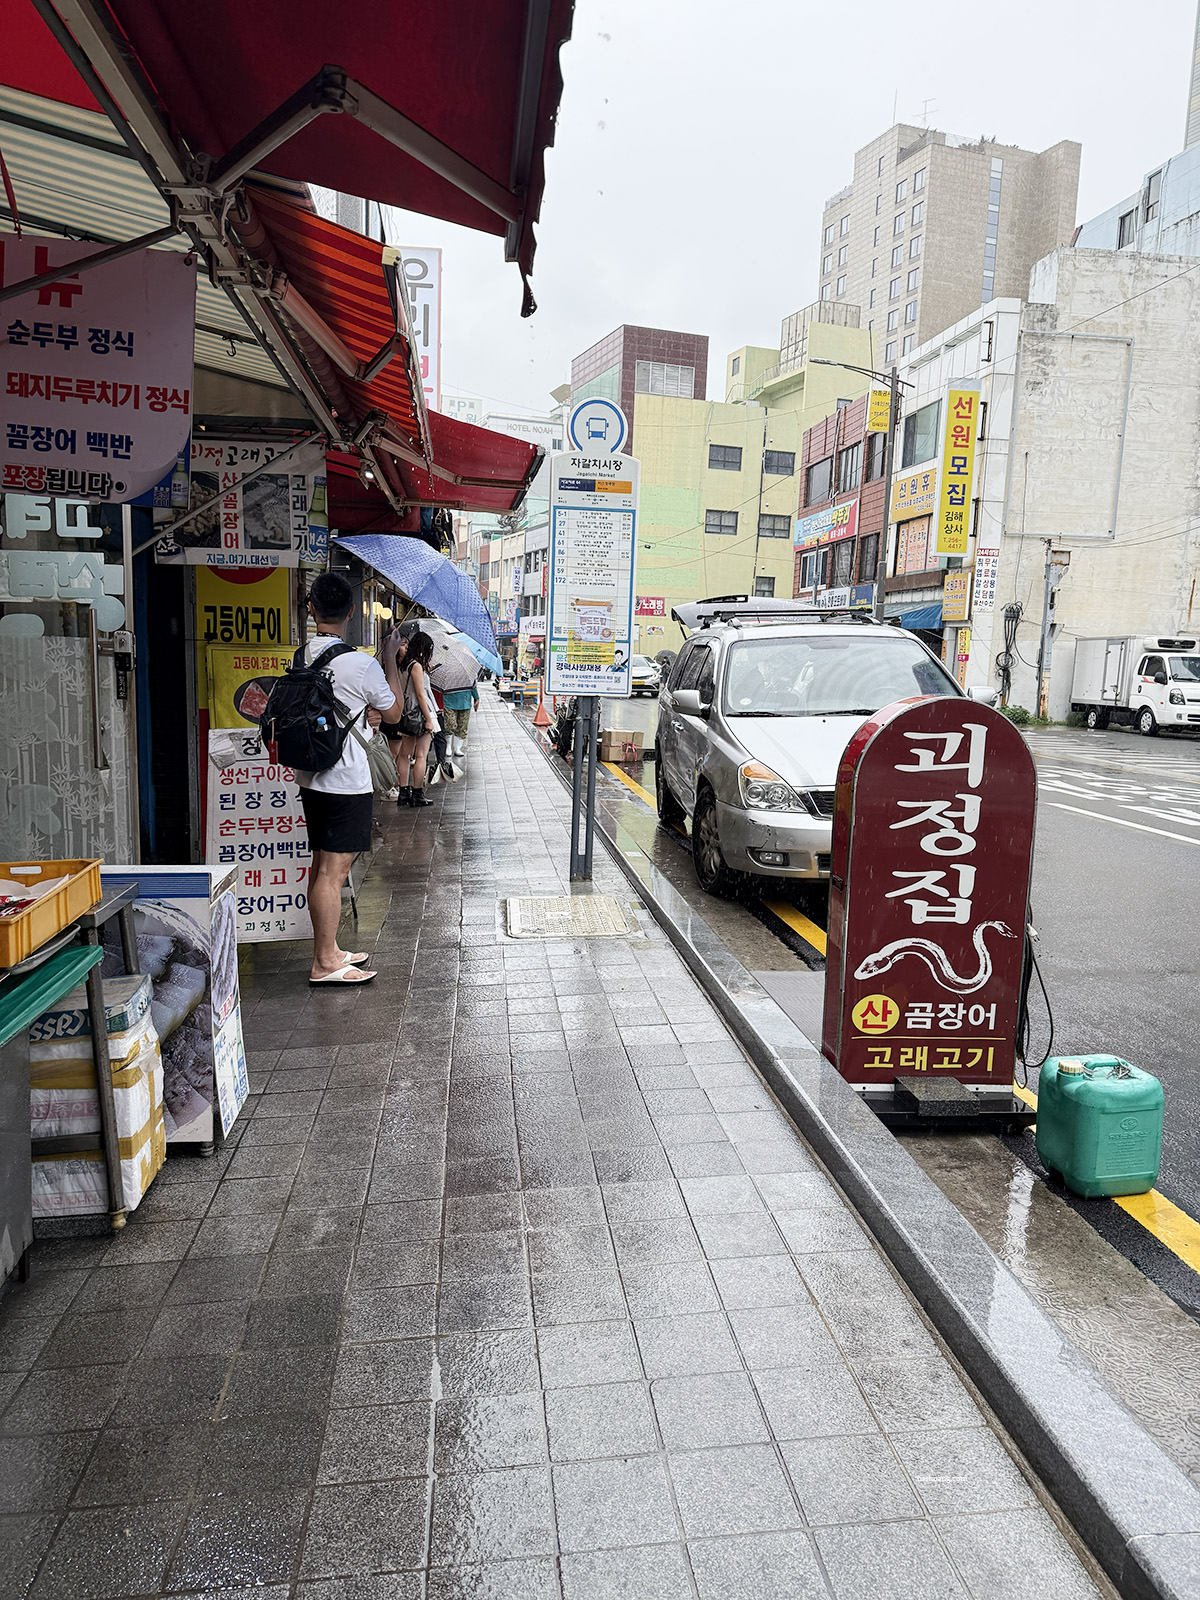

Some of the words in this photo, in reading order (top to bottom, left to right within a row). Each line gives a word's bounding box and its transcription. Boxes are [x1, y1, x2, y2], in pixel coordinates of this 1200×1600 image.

[6, 319, 79, 350] 순두부
[87, 327, 134, 357] 정식
[6, 371, 140, 409] 돼지두루치기
[145, 386, 189, 414] 정식
[6, 423, 76, 454] 꼼장어
[86, 432, 133, 460] 백반
[507, 423, 532, 432] HOTEL
[533, 424, 553, 434] NOAH
[570, 458, 623, 471] 자갈치시장
[947, 396, 973, 506] 선원모집
[291, 475, 308, 551] 고래고기
[944, 511, 963, 521] 김해
[944, 524, 963, 534] 상사
[204, 606, 281, 643] 고등어구이
[884, 722, 988, 925] 괴정집
[859, 1000, 892, 1029] 산
[904, 1002, 997, 1030] 곰장어
[863, 1046, 995, 1072] 고래고기
